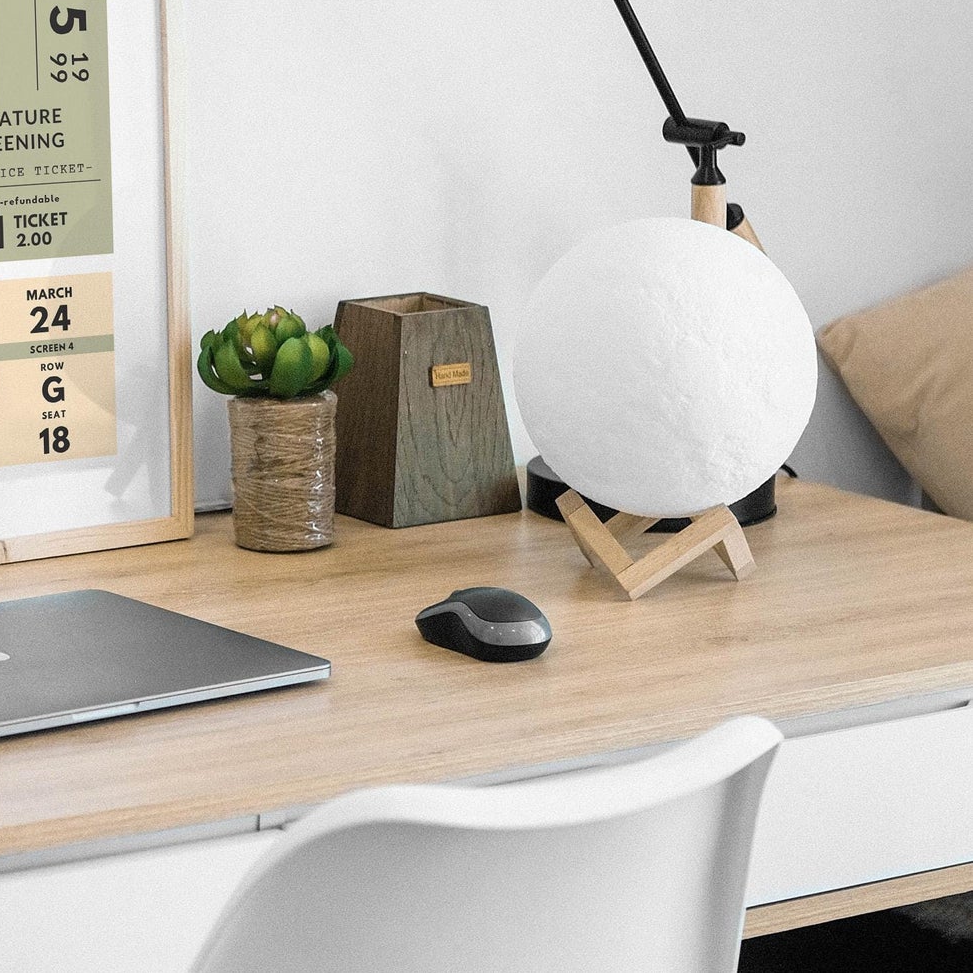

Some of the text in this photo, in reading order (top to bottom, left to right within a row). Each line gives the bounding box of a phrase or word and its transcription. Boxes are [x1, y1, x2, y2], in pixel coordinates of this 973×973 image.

[13, 211, 68, 229] TICKET
[16, 231, 53, 248] 2.00
[26, 286, 73, 301] MARCH
[30, 304, 71, 334] 24
[29, 341, 76, 355] SCREEN 4
[40, 361, 65, 372] ROW
[41, 375, 65, 404] G
[41, 409, 66, 420] SEAT
[39, 425, 71, 455] 18
